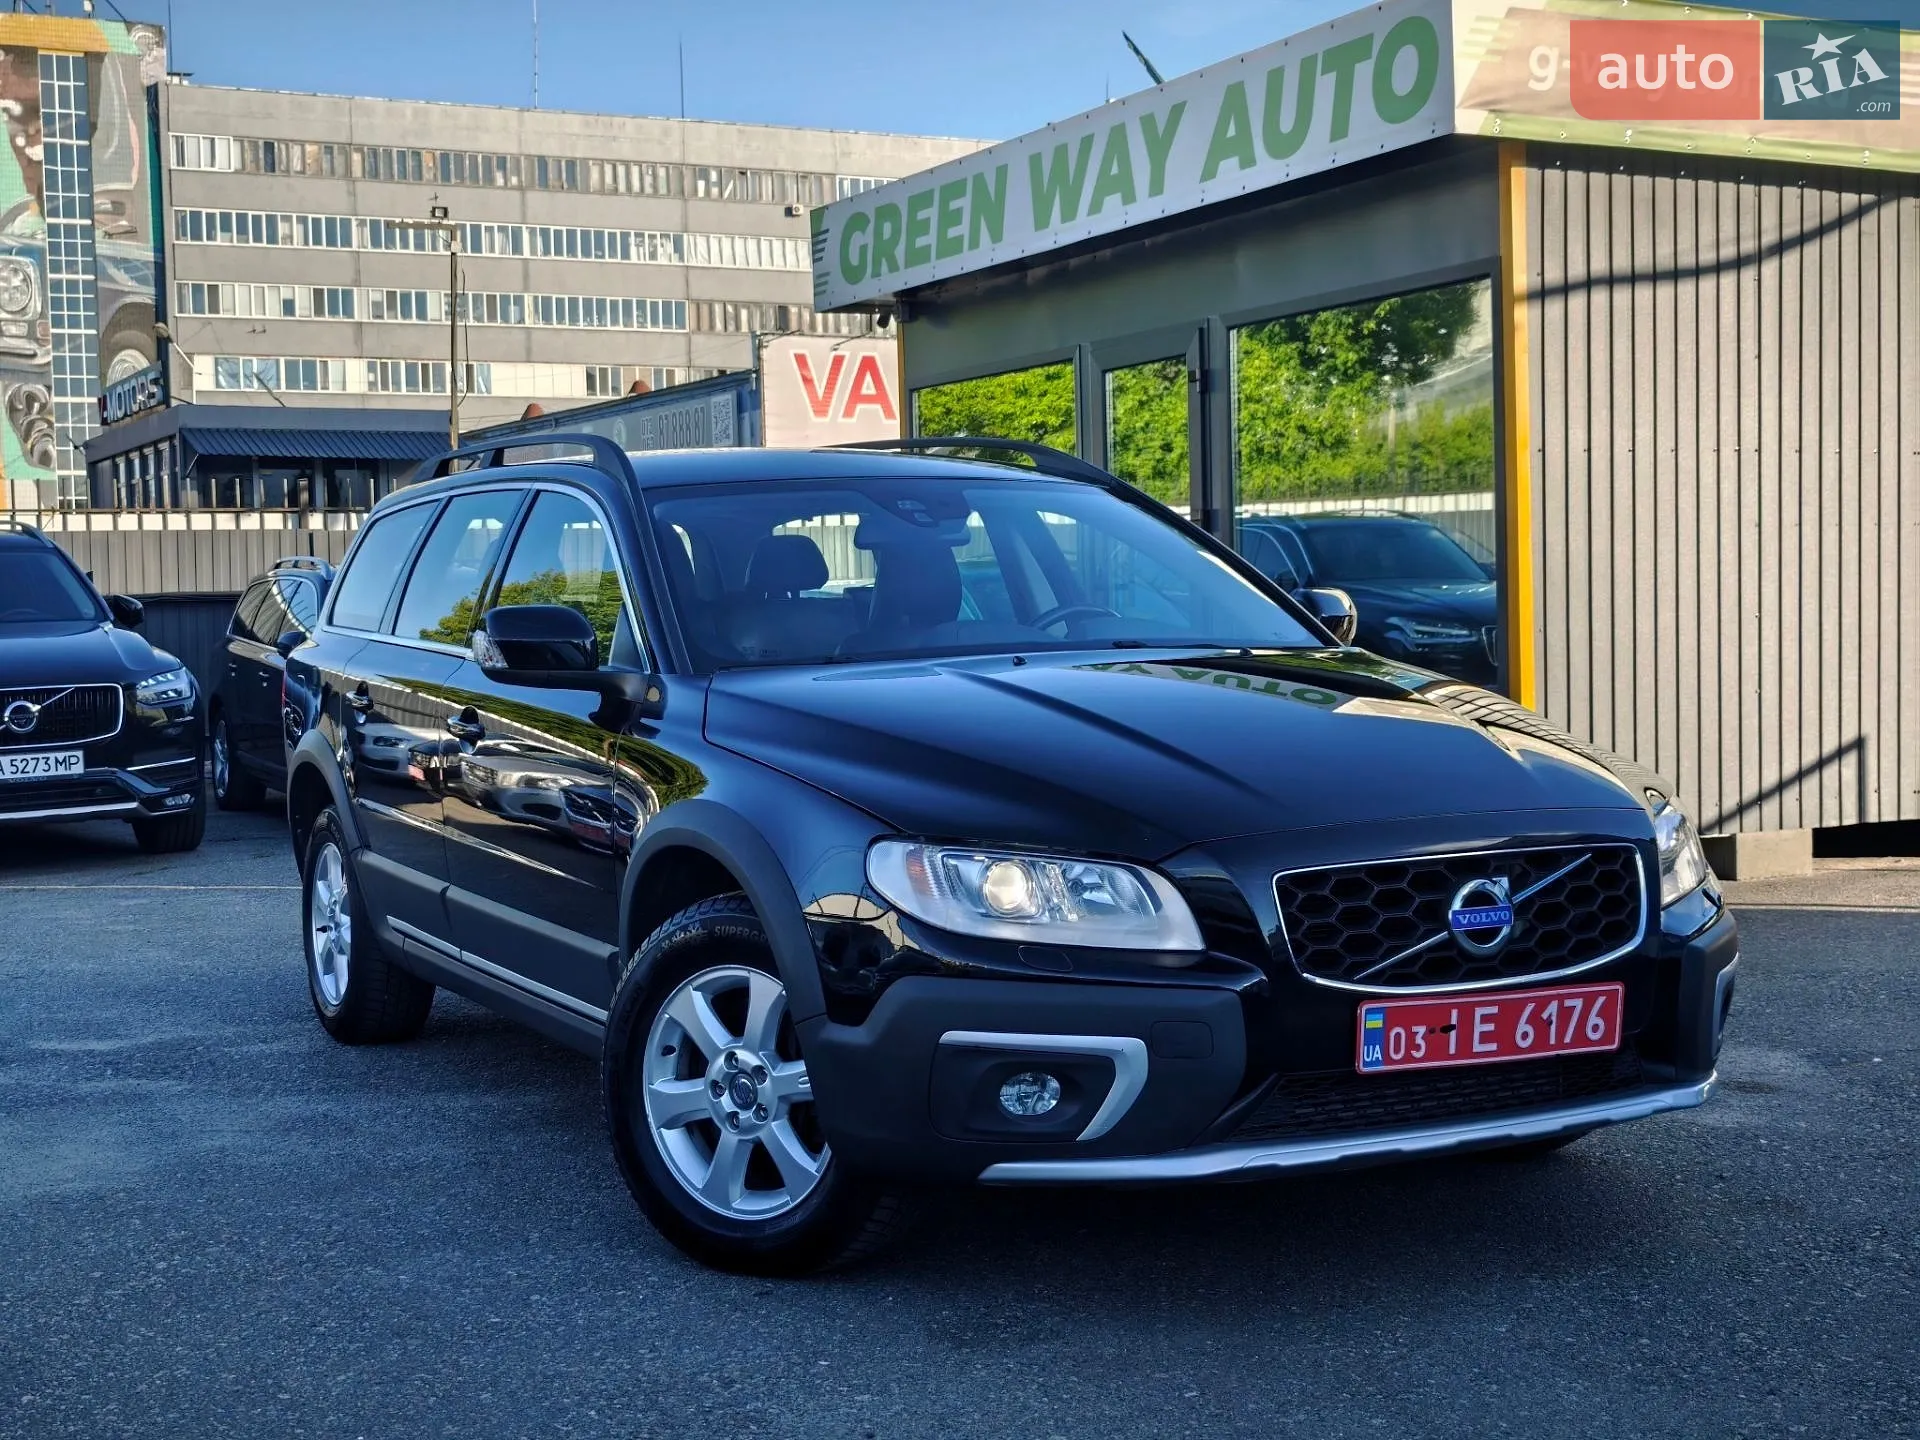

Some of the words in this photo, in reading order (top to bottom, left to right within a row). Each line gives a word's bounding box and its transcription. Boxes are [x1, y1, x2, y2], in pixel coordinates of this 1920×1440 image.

[839, 163, 1009, 286] GREEN
[1028, 100, 1187, 232] WAY
[1199, 15, 1439, 183] AUTO
[10, 756, 51, 775] 5273
[55, 754, 81, 772] MP
[1455, 910, 1510, 925] VOLVO
[1388, 1025, 1427, 1061] 03
[1514, 996, 1607, 1049] 6176
[1364, 1044, 1384, 1063] UA
